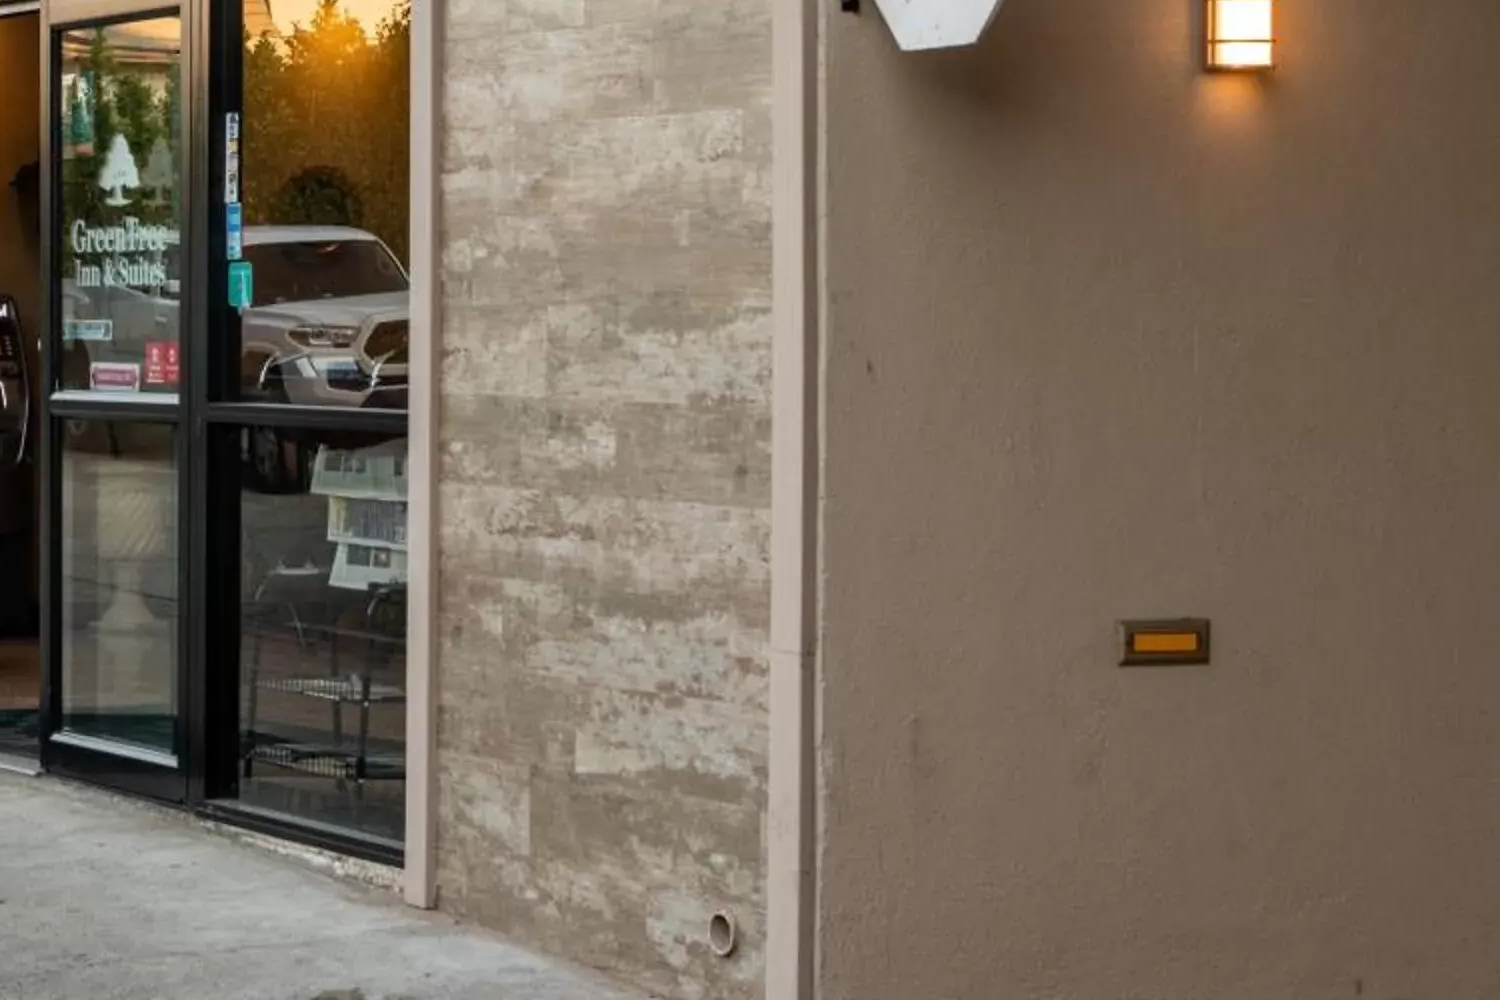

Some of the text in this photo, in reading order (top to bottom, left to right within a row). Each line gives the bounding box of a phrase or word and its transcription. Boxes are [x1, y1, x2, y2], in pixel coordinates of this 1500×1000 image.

[72, 216, 168, 253] GreenTree
[75, 256, 166, 286] Inn & Suites
